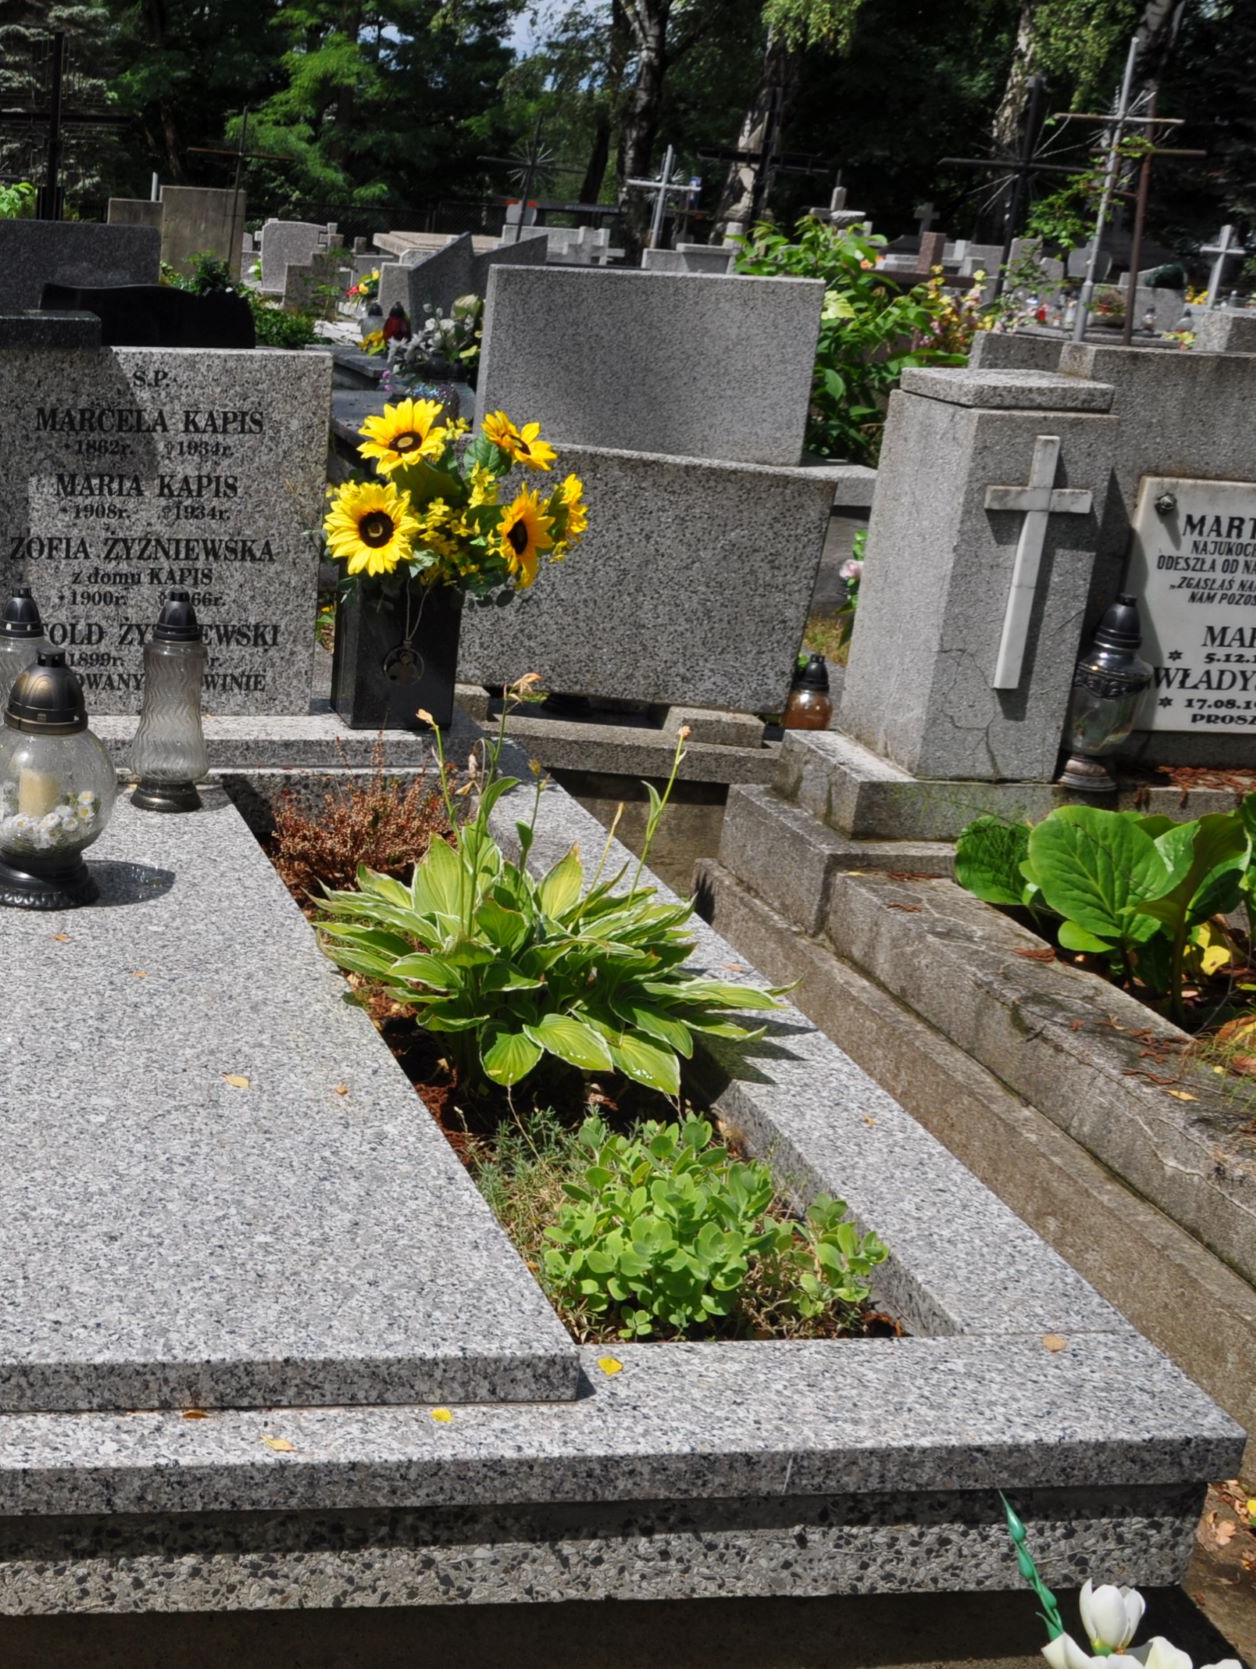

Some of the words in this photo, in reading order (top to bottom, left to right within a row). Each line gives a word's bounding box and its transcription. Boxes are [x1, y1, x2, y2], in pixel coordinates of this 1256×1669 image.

[35, 407, 170, 433] MARCELA
[182, 410, 264, 434] KAPIS
[55, 473, 144, 497] MARIA
[157, 474, 238, 498] KAPIS
[174, 505, 230, 521] 1934r.
[10, 536, 91, 560] ZOFIA
[103, 530, 276, 562] ŻYŹNIEWSKA
[1157, 555, 1216, 573] ODESZŁA
[1221, 559, 1239, 574] OD
[71, 571, 82, 584] z
[87, 566, 143, 585] domu
[148, 567, 214, 586] KAPIS
[1237, 580, 1256, 593] NA
[1188, 591, 1217, 604] NAM
[118, 616, 280, 647] ŻYEWSKI
[1152, 667, 1256, 693] WŁADY
[1184, 698, 1256, 711] 17.08.1
